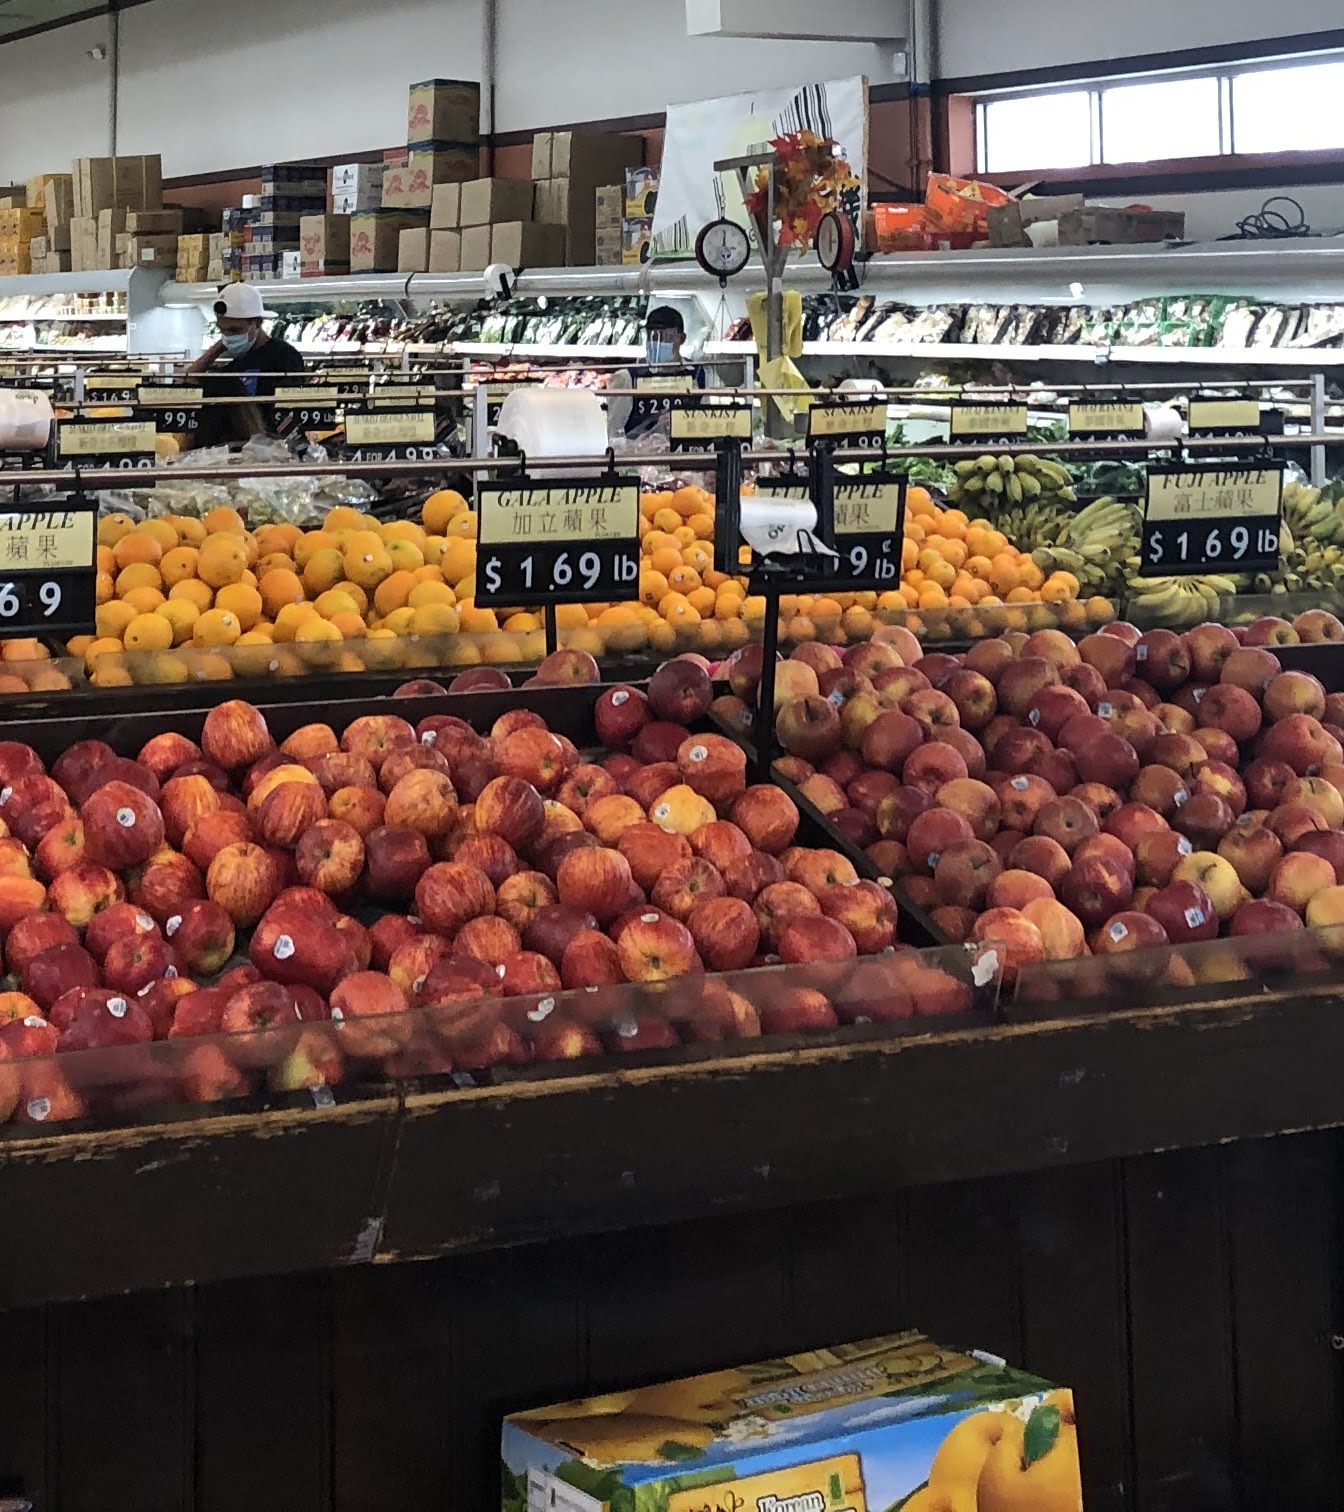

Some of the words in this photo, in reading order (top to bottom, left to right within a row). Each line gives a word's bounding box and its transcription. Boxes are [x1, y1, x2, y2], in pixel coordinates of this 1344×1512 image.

[1209, 470, 1267, 487] APPLE
[497, 489, 552, 508] GALA
[556, 488, 623, 506] APPLE
[835, 484, 884, 500] PPLE
[0, 513, 75, 531] APPLE
[1257, 529, 1278, 553] lb
[614, 554, 638, 581] lb
[874, 559, 896, 579] lb
